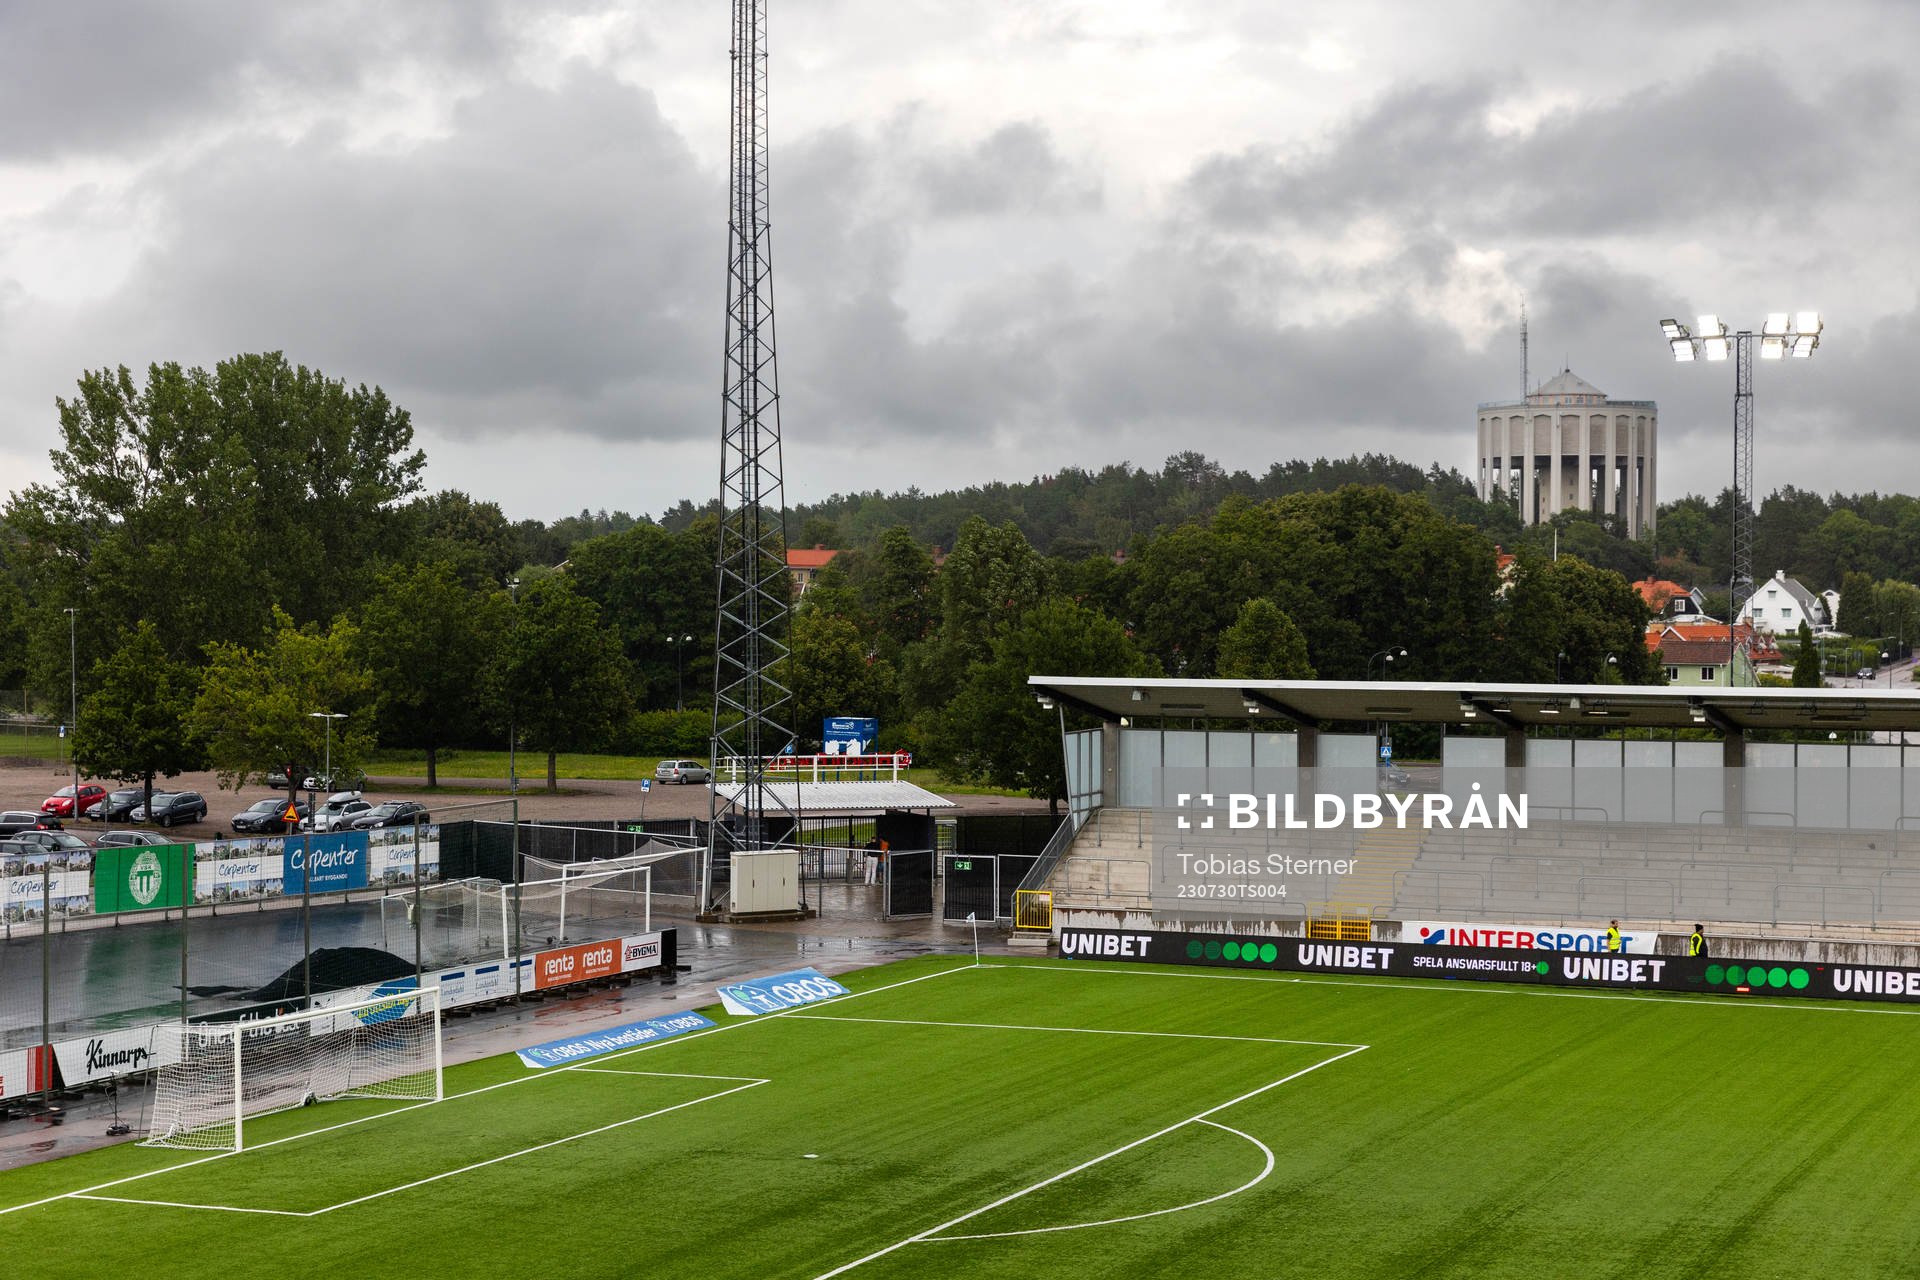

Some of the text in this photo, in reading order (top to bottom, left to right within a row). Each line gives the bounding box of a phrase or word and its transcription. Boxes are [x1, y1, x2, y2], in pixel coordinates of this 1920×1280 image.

[389, 846, 422, 862] Carpentr
[11, 880, 59, 897] Carpener
[632, 945, 657, 958] BYGMA
[1061, 933, 1152, 957] UNIBET
[1298, 943, 1395, 970] UNIBET
[544, 954, 575, 976] renta
[582, 947, 613, 968] renta
[1413, 957, 1537, 972] SPELA ANSVARSFULLT 18+
[1563, 957, 1666, 983] UNIBET
[772, 976, 842, 1004] OBOS
[556, 1015, 704, 1058] OBOS Nya bostäder OBOS
[86, 1039, 152, 1075] Kinnarps
